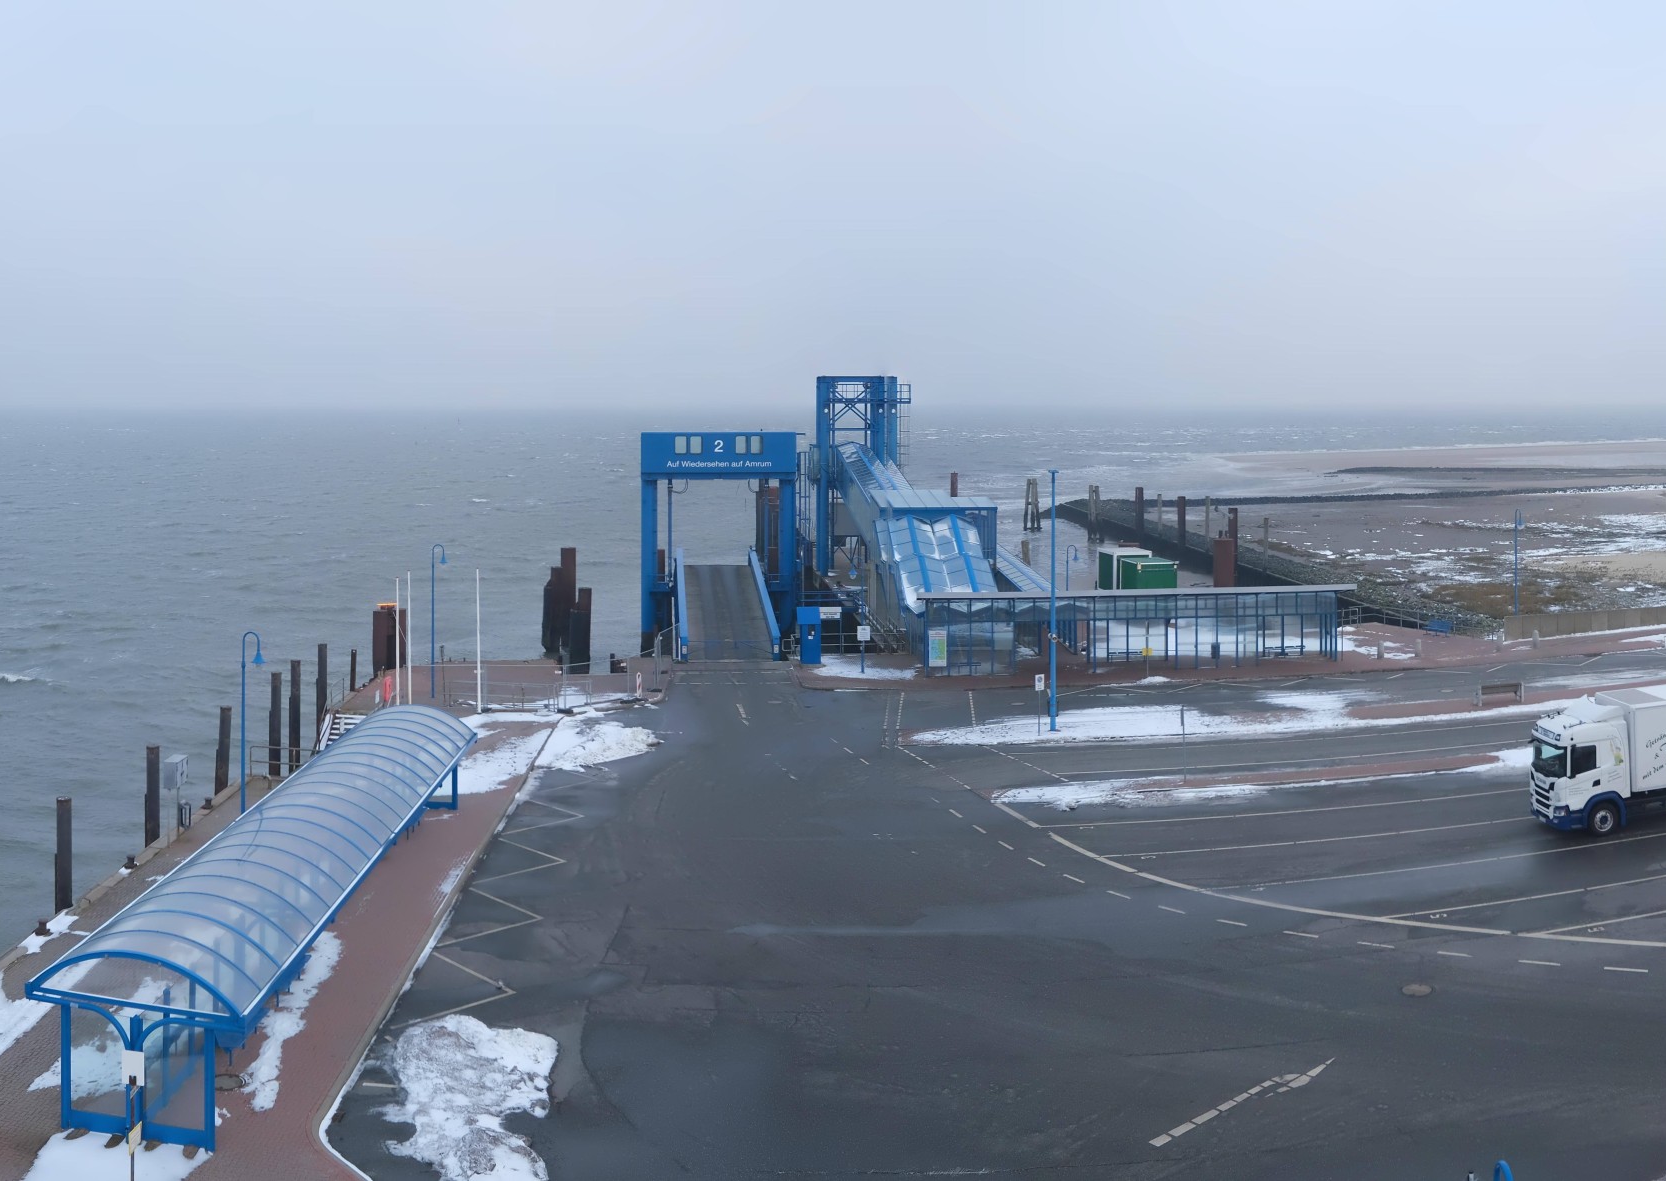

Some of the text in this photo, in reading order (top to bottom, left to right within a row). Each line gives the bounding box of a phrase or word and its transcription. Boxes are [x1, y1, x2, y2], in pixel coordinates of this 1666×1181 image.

[714, 440, 724, 452] 2
[1642, 771, 1652, 780] mit
[1653, 765, 1664, 773] dem
